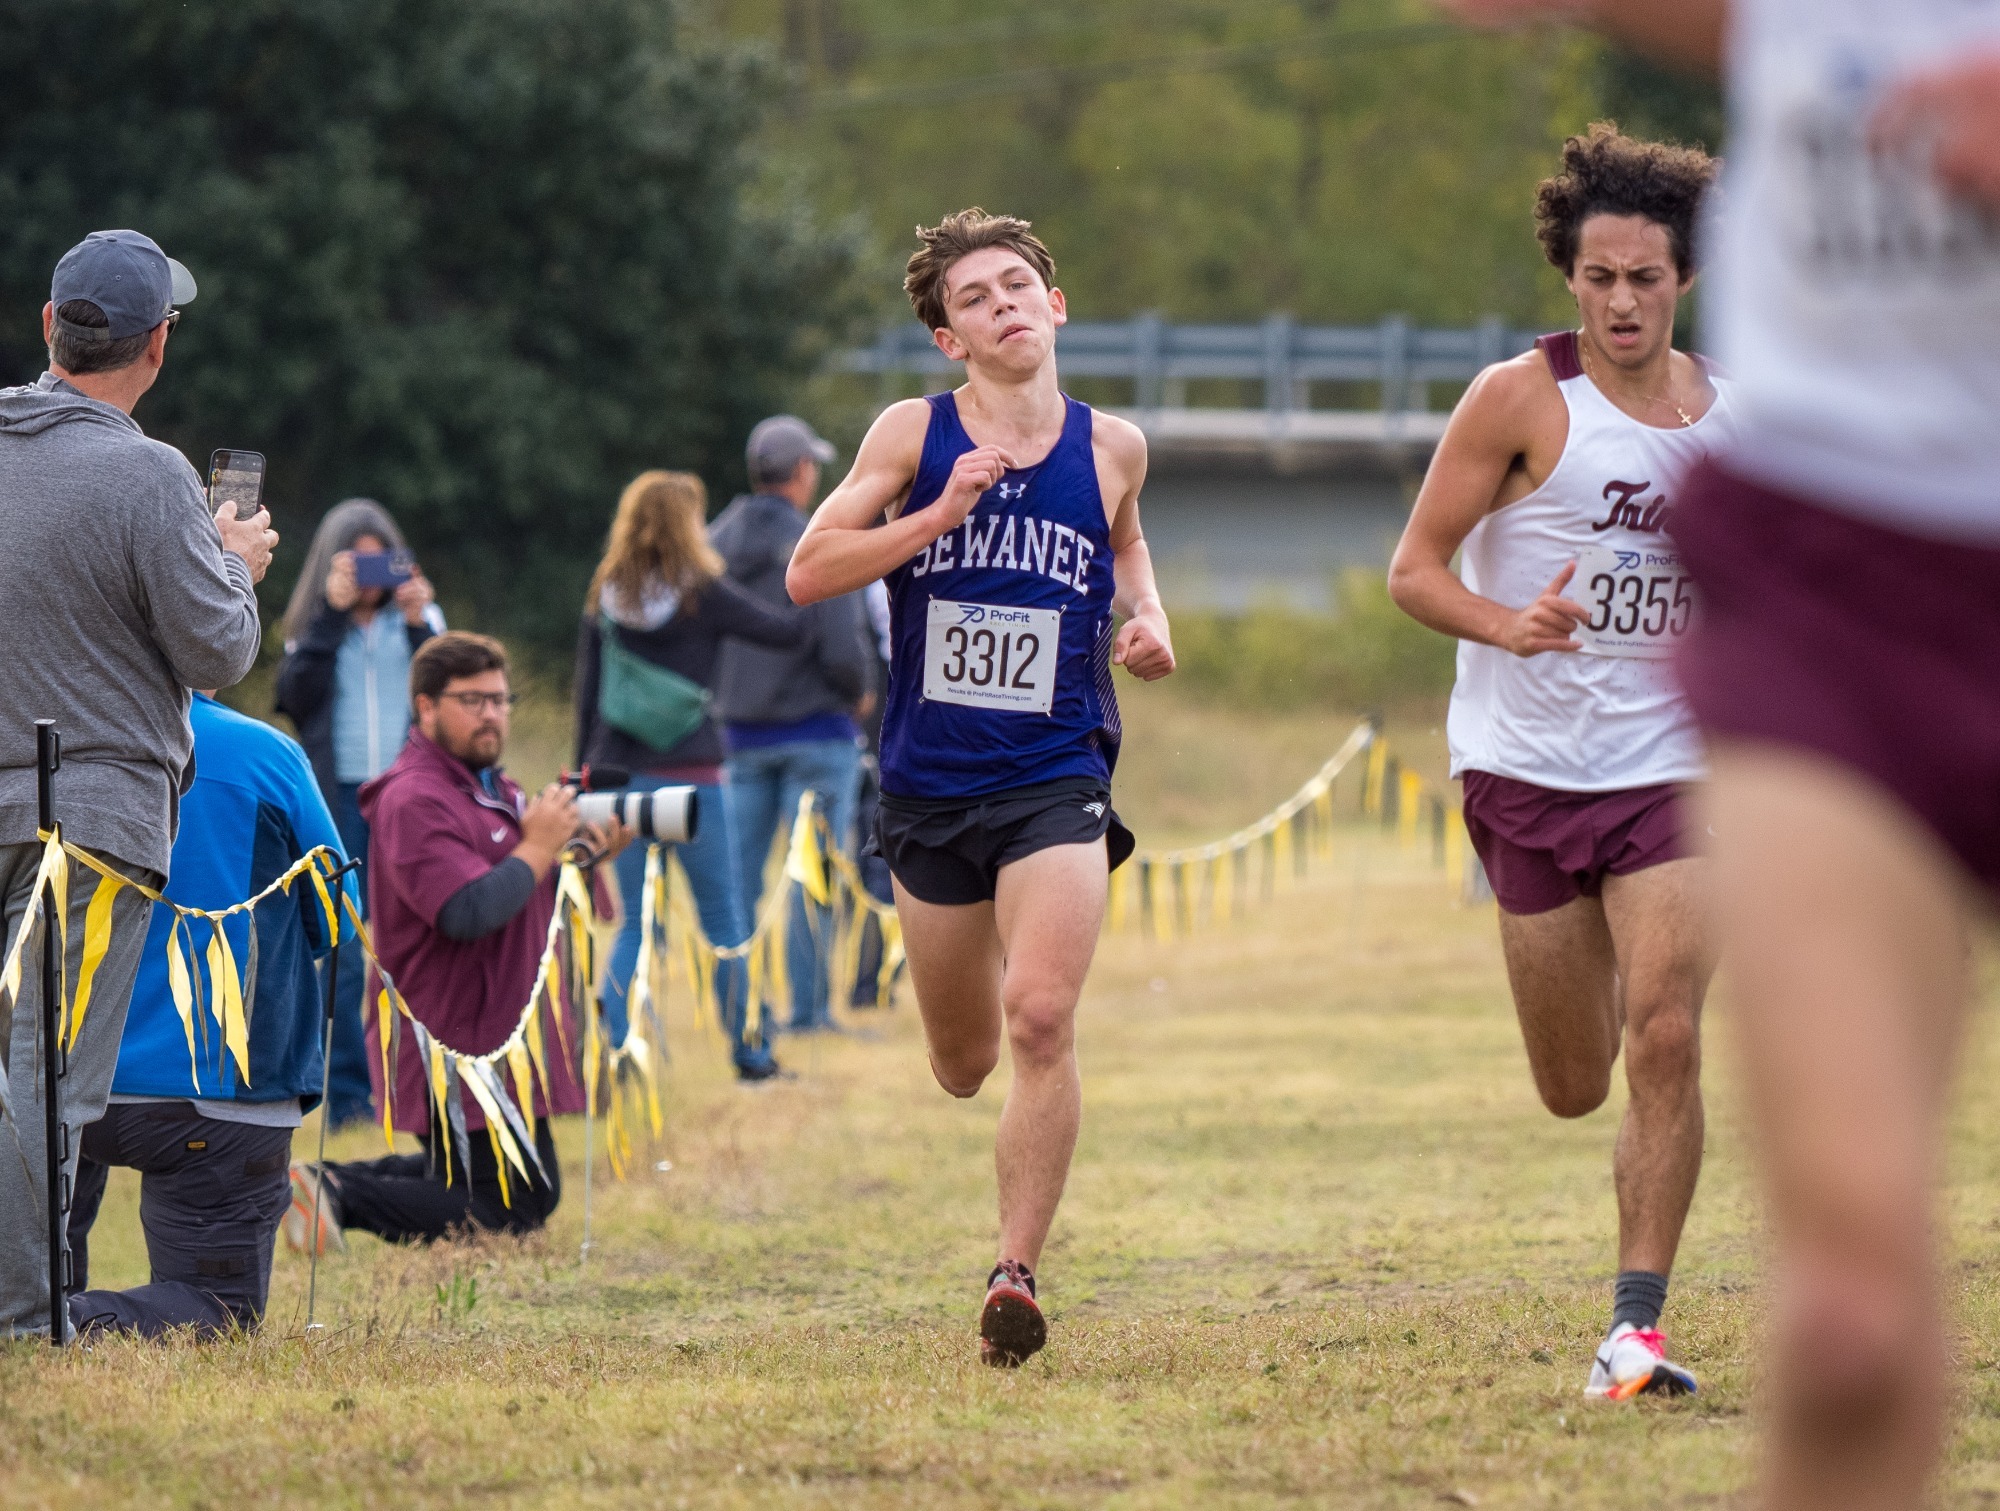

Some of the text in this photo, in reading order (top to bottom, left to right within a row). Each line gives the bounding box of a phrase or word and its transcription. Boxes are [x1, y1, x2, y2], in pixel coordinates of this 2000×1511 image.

[912, 514, 1095, 597] SEWANEE
[1645, 553, 1683, 566] ProFi
[990, 609, 1031, 623] ProFit
[1586, 573, 1694, 637] 3355
[943, 626, 1040, 690] 3312
[947, 686, 966, 696] Results
[972, 690, 1033, 702] ProFitRaceTiming.com
